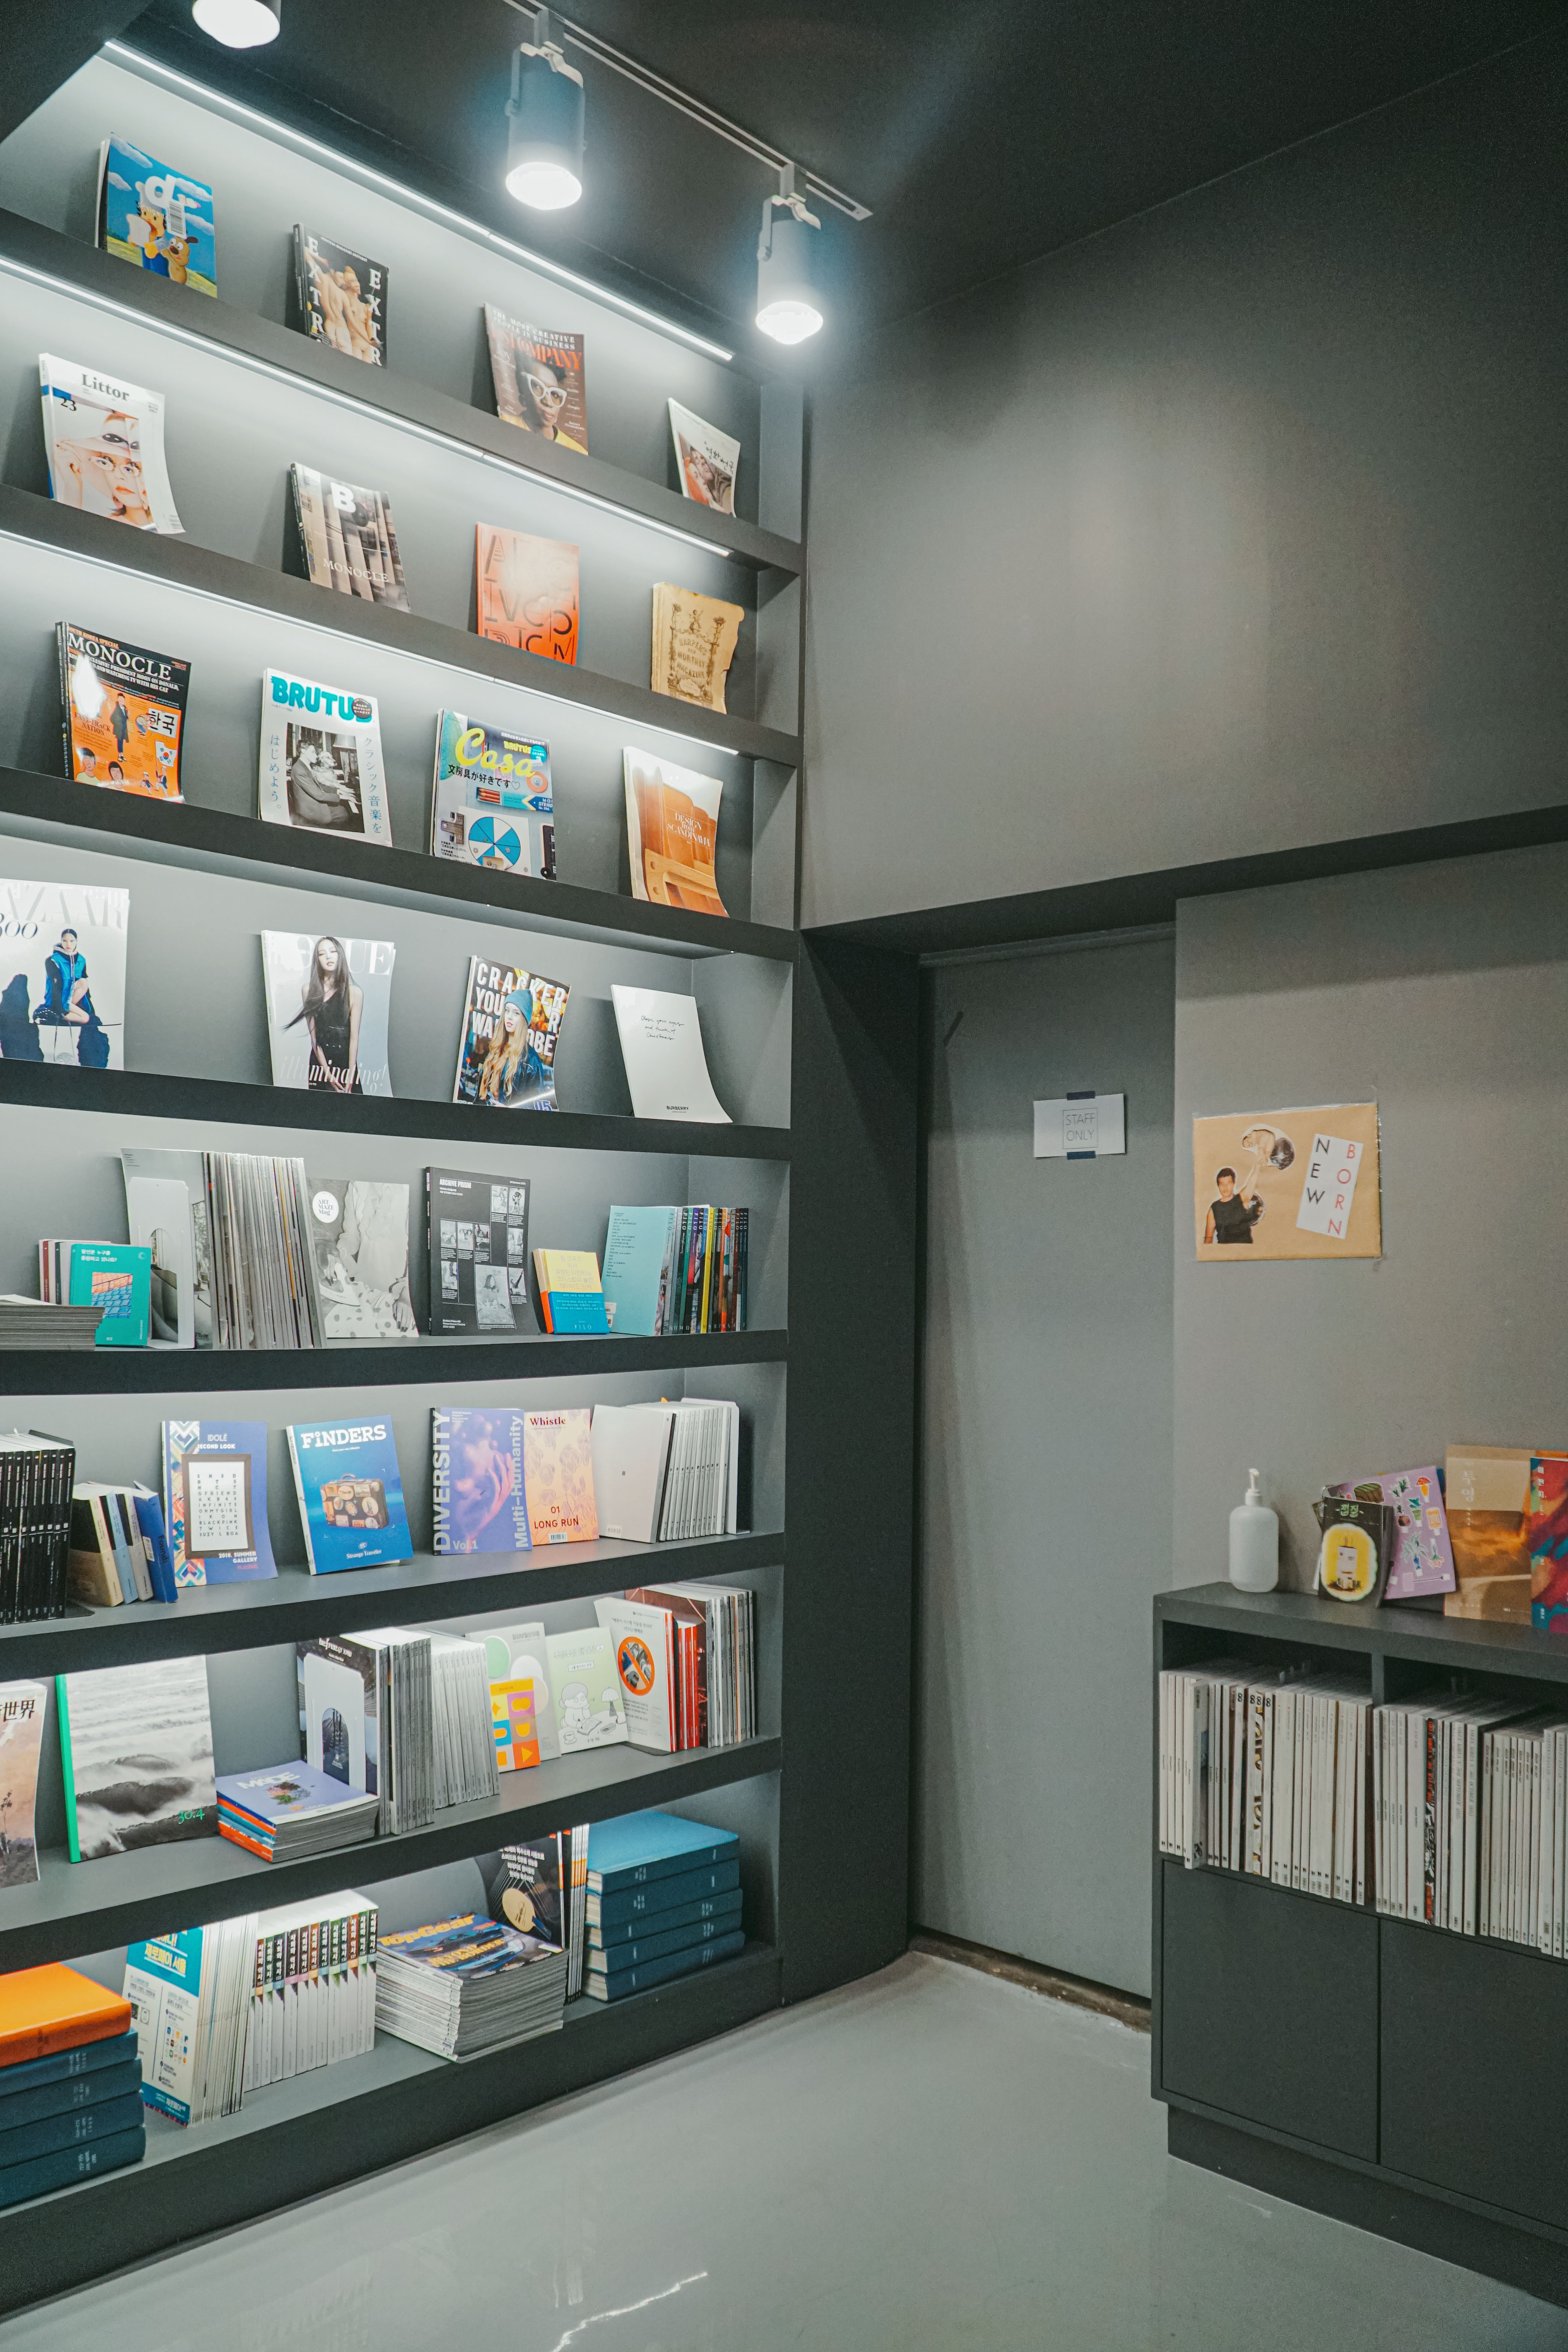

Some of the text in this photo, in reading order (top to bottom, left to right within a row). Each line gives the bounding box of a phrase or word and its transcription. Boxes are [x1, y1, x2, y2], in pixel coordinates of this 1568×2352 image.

[145, 174, 176, 208] d
[307, 236, 325, 334] EXTR
[533, 328, 575, 343] CREATIVE
[533, 335, 575, 350] BUSINESS
[82, 373, 129, 401] Littor
[60, 397, 77, 411] 23
[330, 482, 356, 513] B
[323, 558, 389, 582] MONOCLE
[99, 637, 119, 648] SPECIAL
[68, 632, 172, 681] MONOCLE
[136, 673, 151, 682] MOON
[82, 722, 105, 736] NATION
[455, 728, 535, 777] Casa
[503, 740, 531, 754] BRUTUS
[269, 734, 281, 809] はじめよう。
[448, 764, 511, 788] 文房具が好きです
[364, 736, 381, 833] クラシック音楽を
[675, 812, 702, 831] DESIGN
[682, 822, 695, 833] from
[667, 822, 711, 848] SCANDINAVIA
[477, 962, 566, 1010] CRACKER
[472, 1010, 555, 1057] WAOBE
[1066, 1113, 1095, 1125] STAFF
[1066, 1129, 1095, 1141] ONLY
[439, 1178, 472, 1189] ARCHIVE PRISM
[530, 1416, 566, 1427] Whistle
[433, 1409, 450, 1551] DIVERSITY
[510, 1416, 528, 1548] Multi-Humanity
[534, 1517, 579, 1529] LONG RUN
[453, 1540, 478, 1550] Vol.1
[0, 1699, 35, 1722] 世界
[178, 1808, 205, 1825] 30.4
[377, 1913, 475, 1946] TopGear
[173, 1956, 186, 1974] 서울
